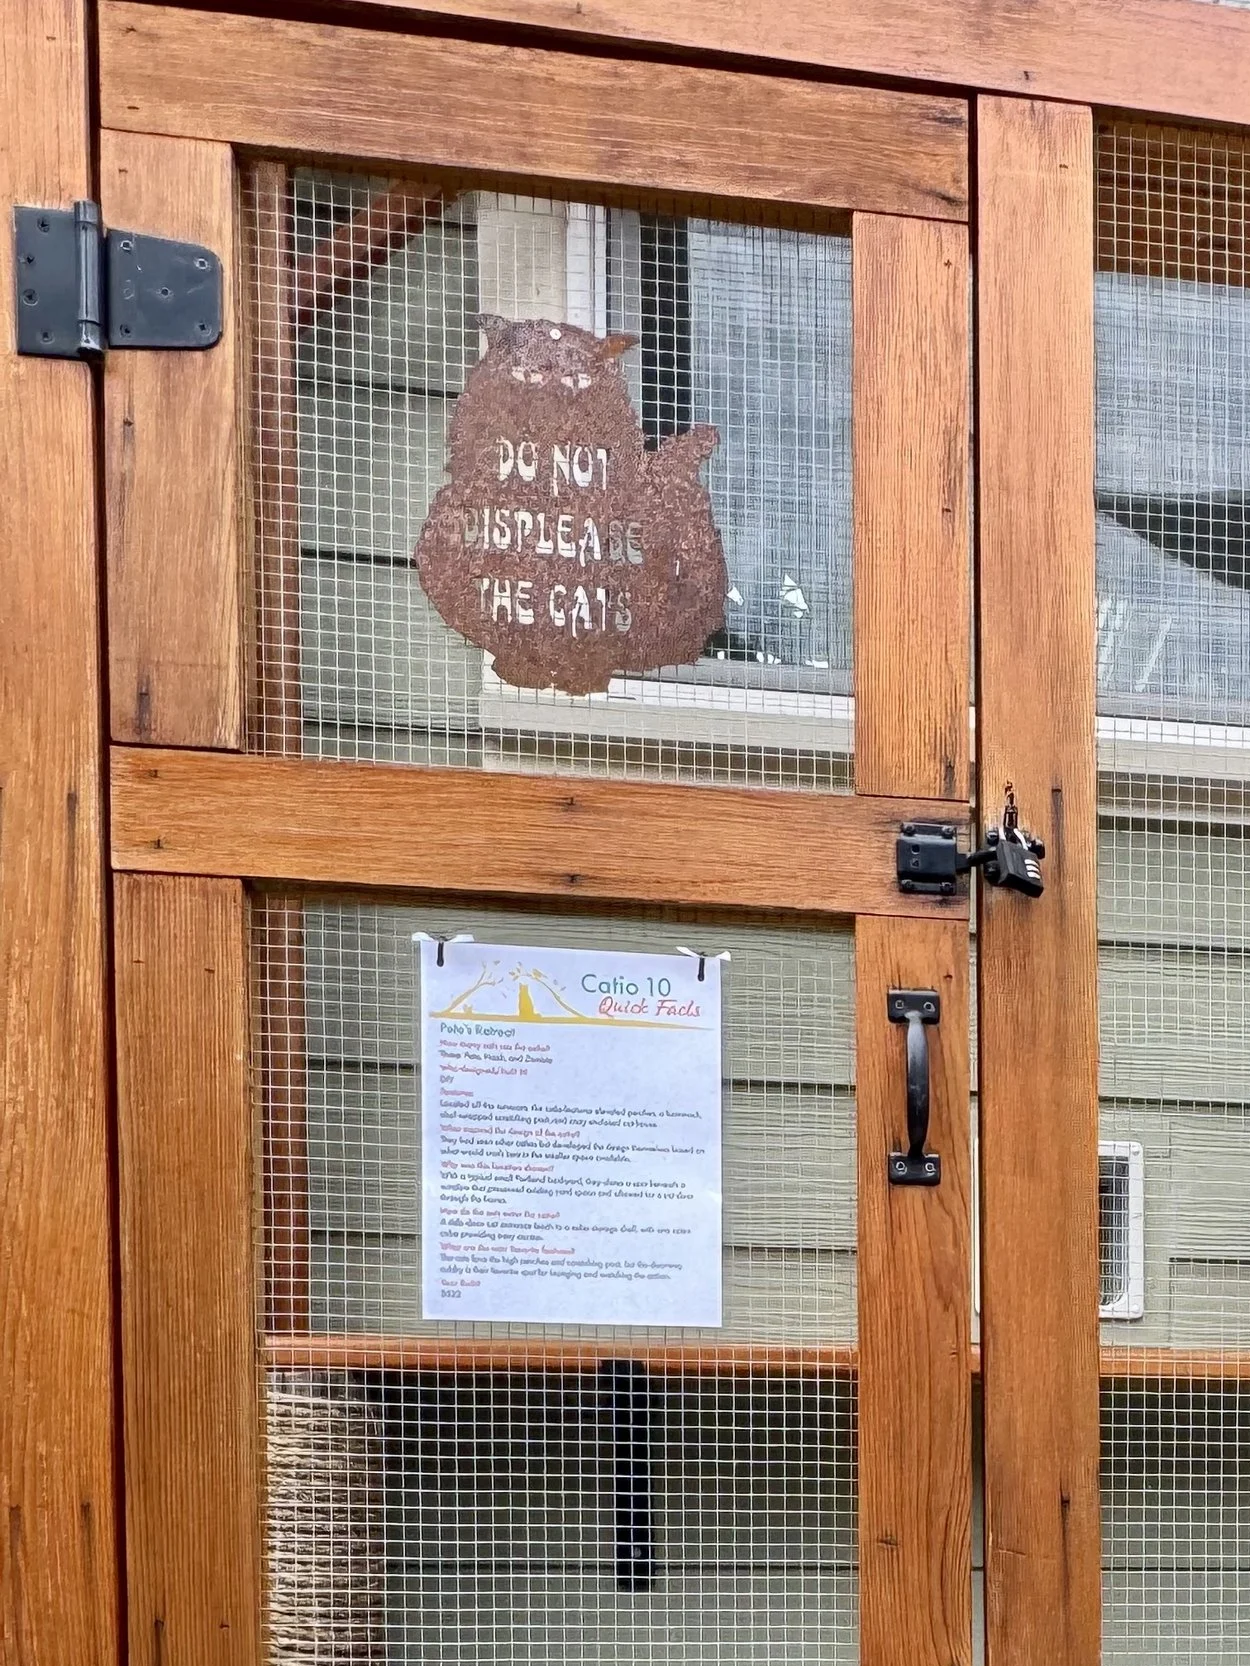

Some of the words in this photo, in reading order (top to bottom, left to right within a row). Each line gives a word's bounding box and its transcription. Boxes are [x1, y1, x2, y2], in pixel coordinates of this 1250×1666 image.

[496, 435, 539, 482] DO
[552, 443, 609, 496] NOT
[464, 506, 645, 567] DISPLEASE
[477, 576, 535, 626] THE
[549, 583, 634, 638] CATS
[581, 973, 639, 996] Catio
[646, 976, 671, 997] 10
[598, 996, 649, 1018] Quick
[655, 999, 701, 1018] Facts
